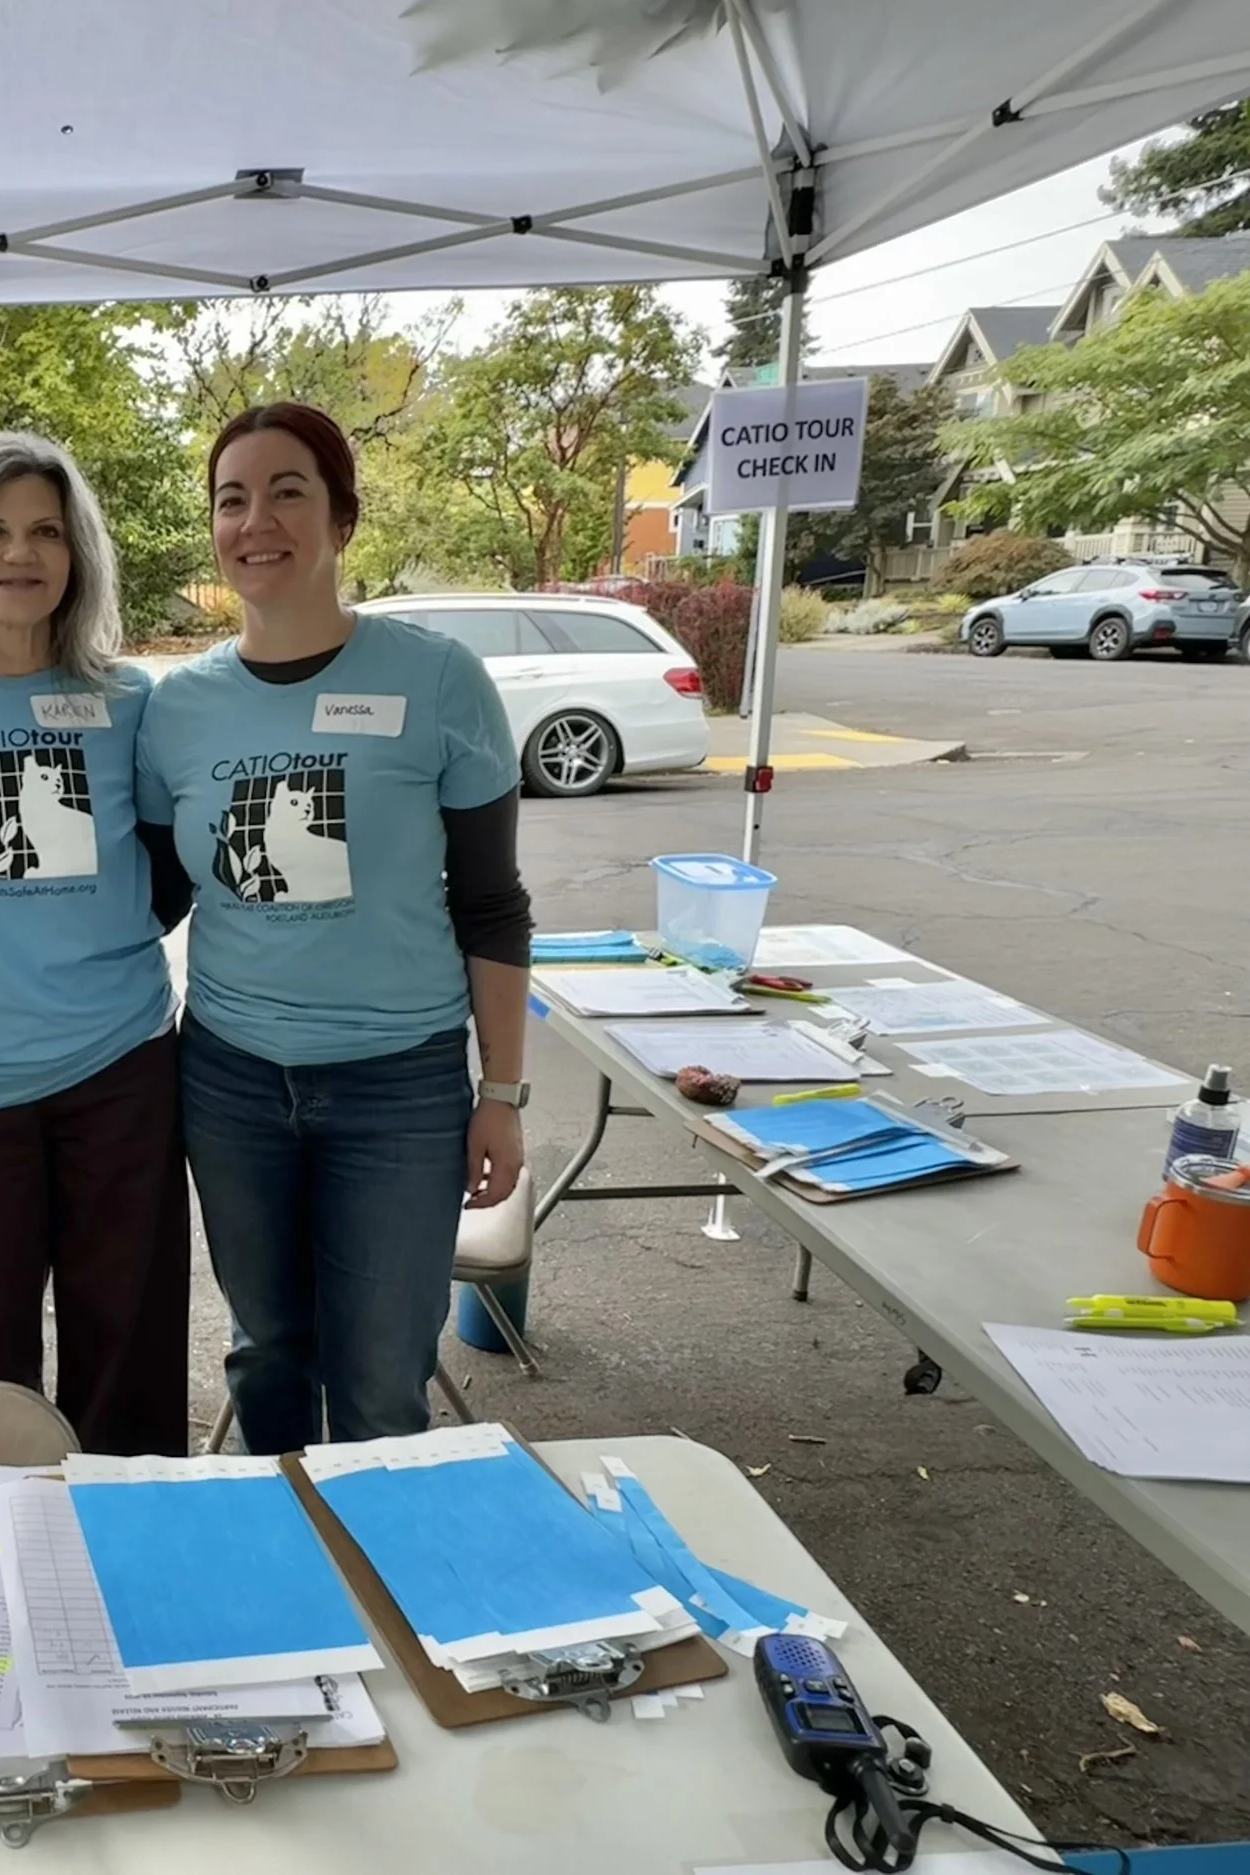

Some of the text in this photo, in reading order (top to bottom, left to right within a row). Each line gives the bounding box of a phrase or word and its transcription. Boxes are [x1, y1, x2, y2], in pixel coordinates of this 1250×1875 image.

[721, 417, 854, 447] CATIO TOUR
[737, 452, 837, 479] CHECK IN
[324, 703, 374, 716] Vanessa
